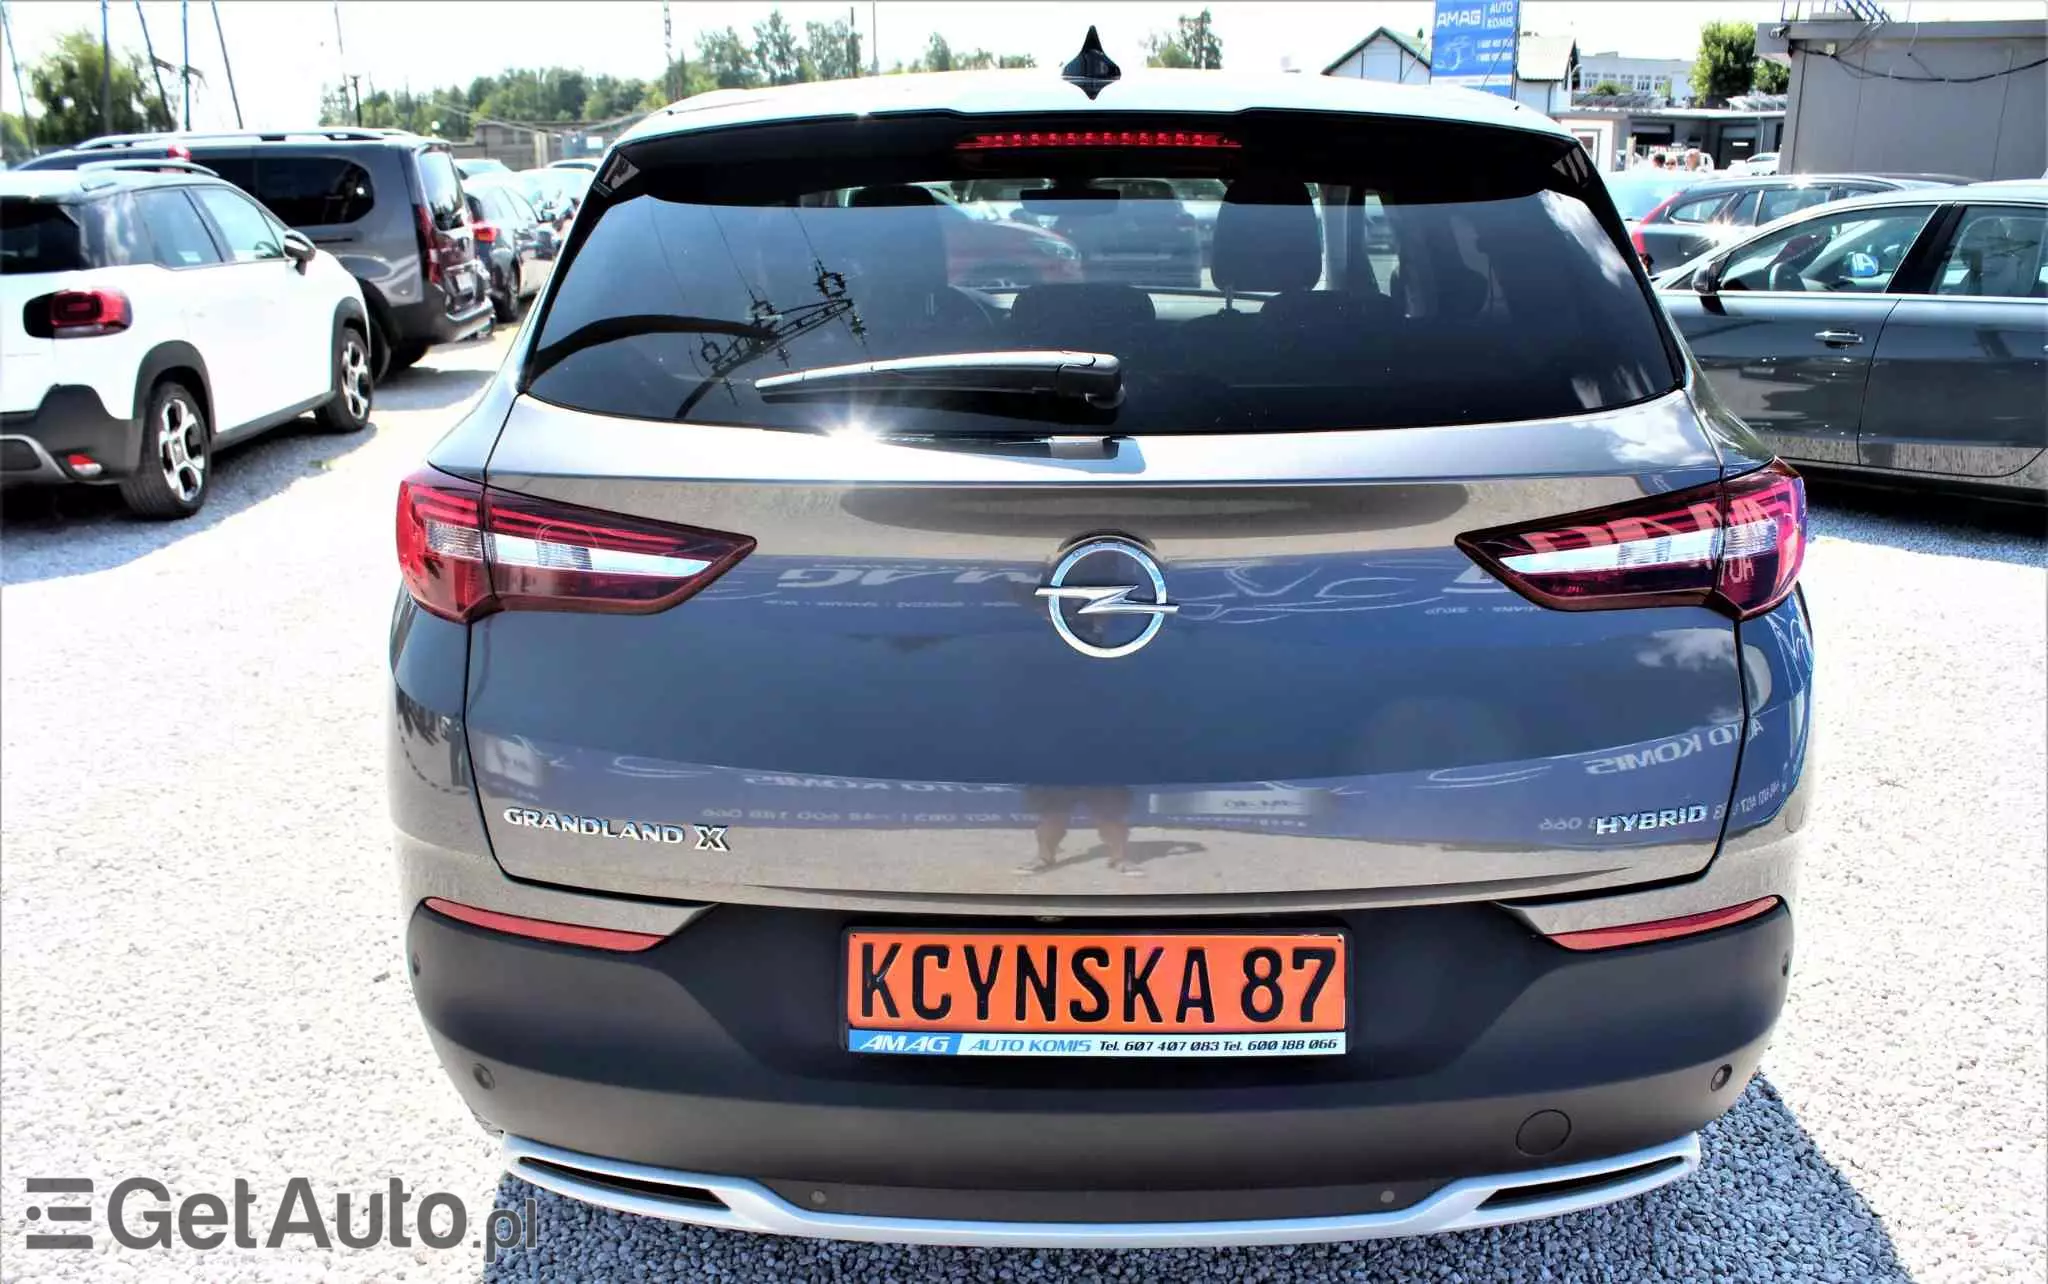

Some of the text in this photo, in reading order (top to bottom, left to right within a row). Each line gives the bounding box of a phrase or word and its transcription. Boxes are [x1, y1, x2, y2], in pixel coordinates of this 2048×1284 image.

[1437, 9, 1481, 28] AMAG
[1489, 1, 1513, 14] AUTO
[503, 807, 731, 851] GRANDLAND X
[1596, 805, 1708, 835] HYBRID
[860, 942, 1338, 1024] KCYNSKA 87
[859, 1034, 1337, 1053] AMAG AUTO KOMIS Tel. 607 407 083 Tel. 600 188 066
